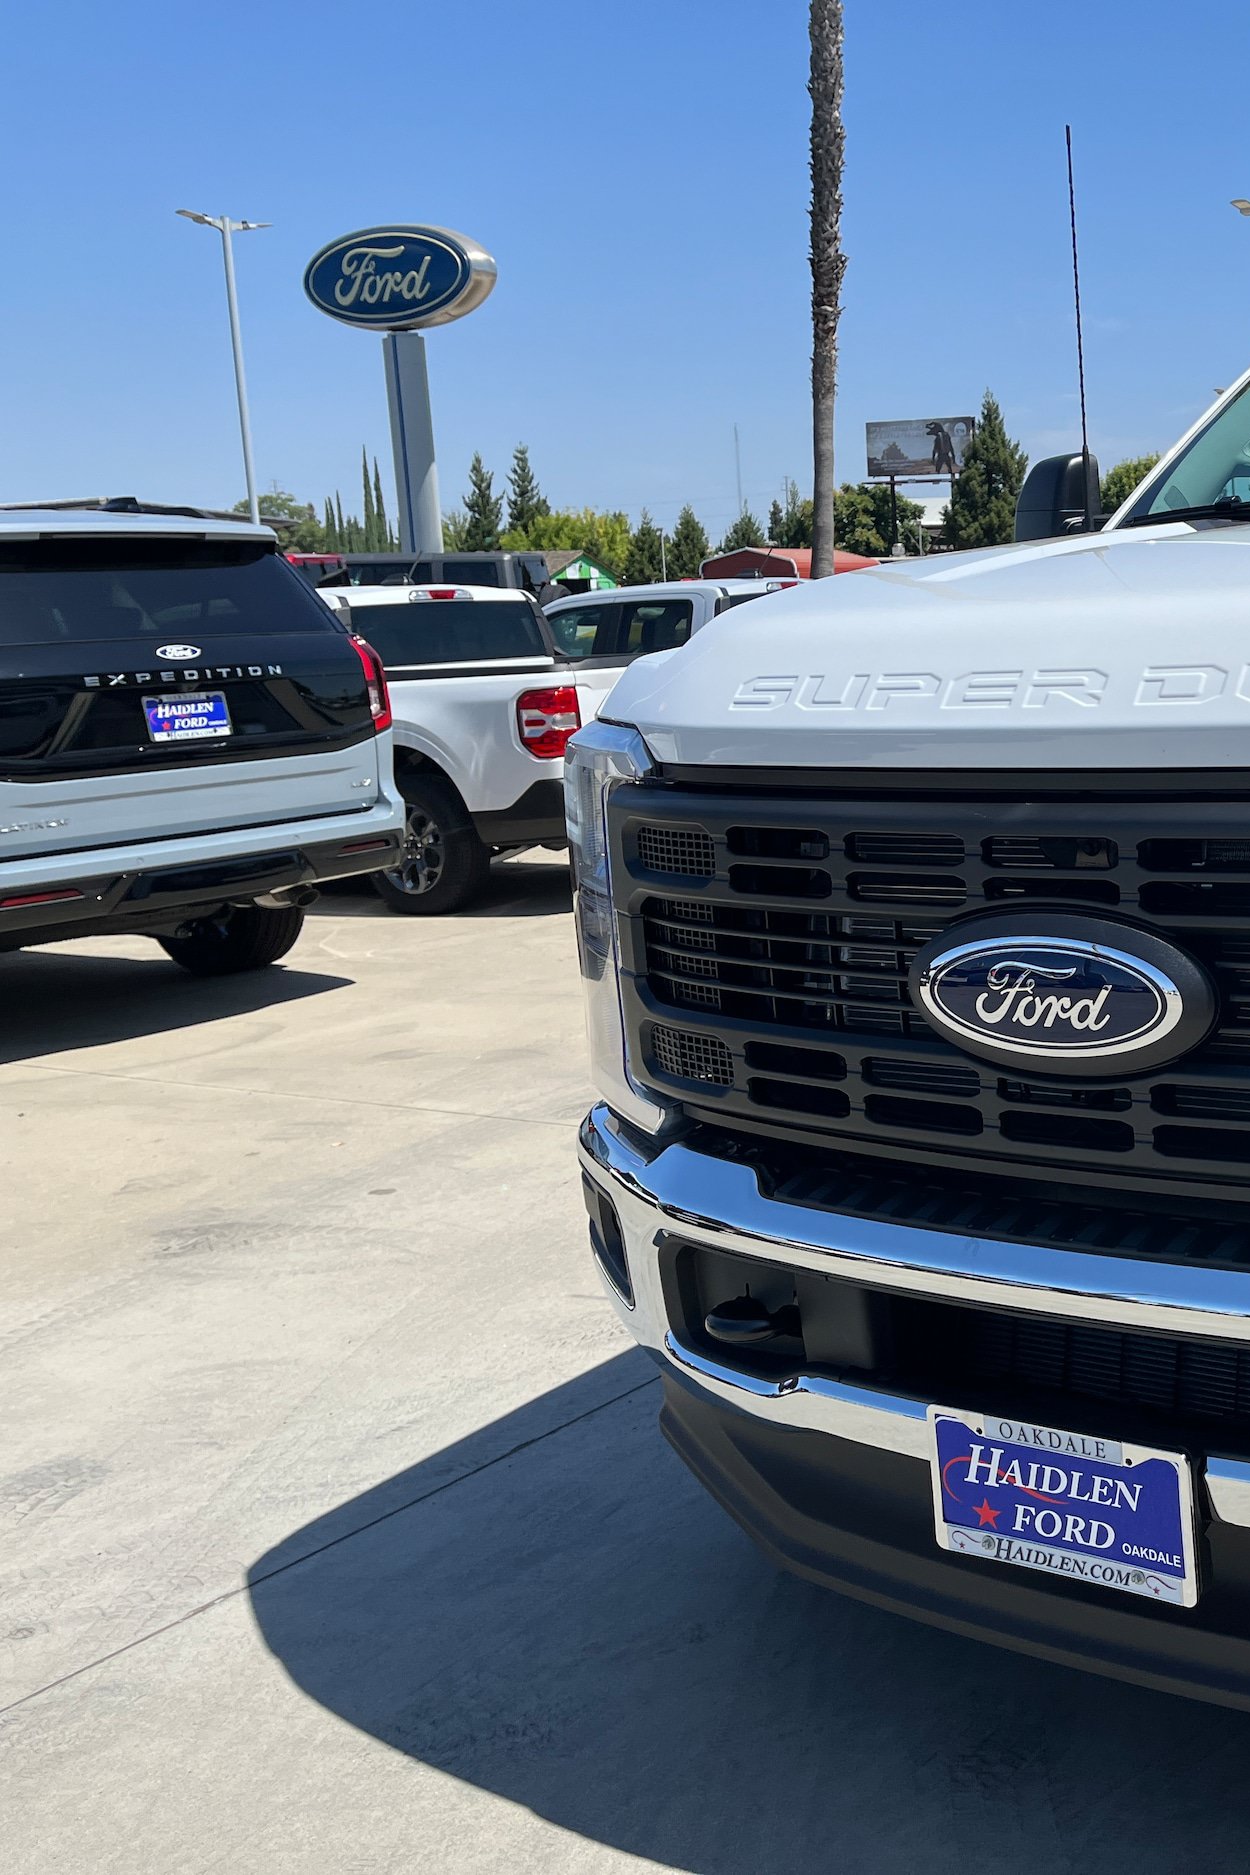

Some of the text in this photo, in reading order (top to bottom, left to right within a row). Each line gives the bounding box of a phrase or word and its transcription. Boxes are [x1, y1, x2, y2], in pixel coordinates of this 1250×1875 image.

[334, 245, 431, 306] Ford
[83, 664, 283, 688] EXPEDITION
[728, 667, 1110, 711] SUPER
[157, 702, 214, 718] HAIDLEN
[174, 717, 208, 729] FORD
[975, 960, 1112, 1031] Ford
[999, 1421, 1106, 1459] OAKDALE
[964, 1443, 1143, 1512] HAIDLEN
[1012, 1503, 1116, 1550] FORD
[995, 1537, 1131, 1587] HAIDLEN.COM
[1121, 1543, 1182, 1568] OAKDALE
